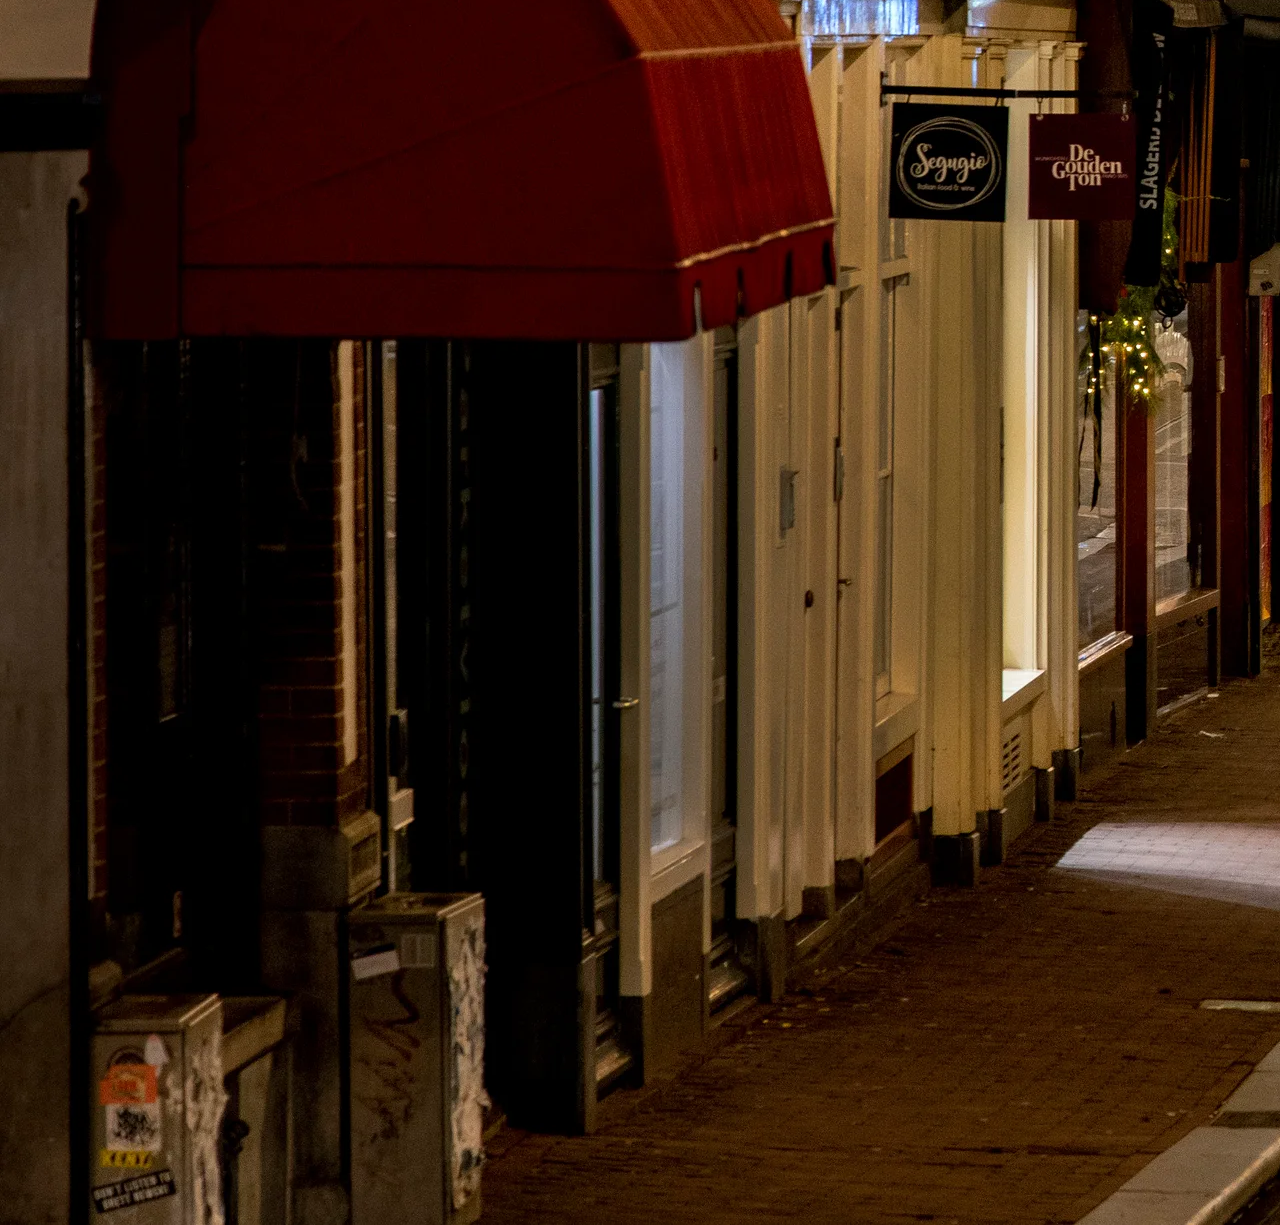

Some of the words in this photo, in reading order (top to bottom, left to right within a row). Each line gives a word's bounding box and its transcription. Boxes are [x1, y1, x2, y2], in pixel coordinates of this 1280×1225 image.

[910, 142, 987, 183] Segugio
[1069, 143, 1095, 162] De
[1051, 155, 1123, 180] Gouden
[1065, 173, 1102, 192] Ton
